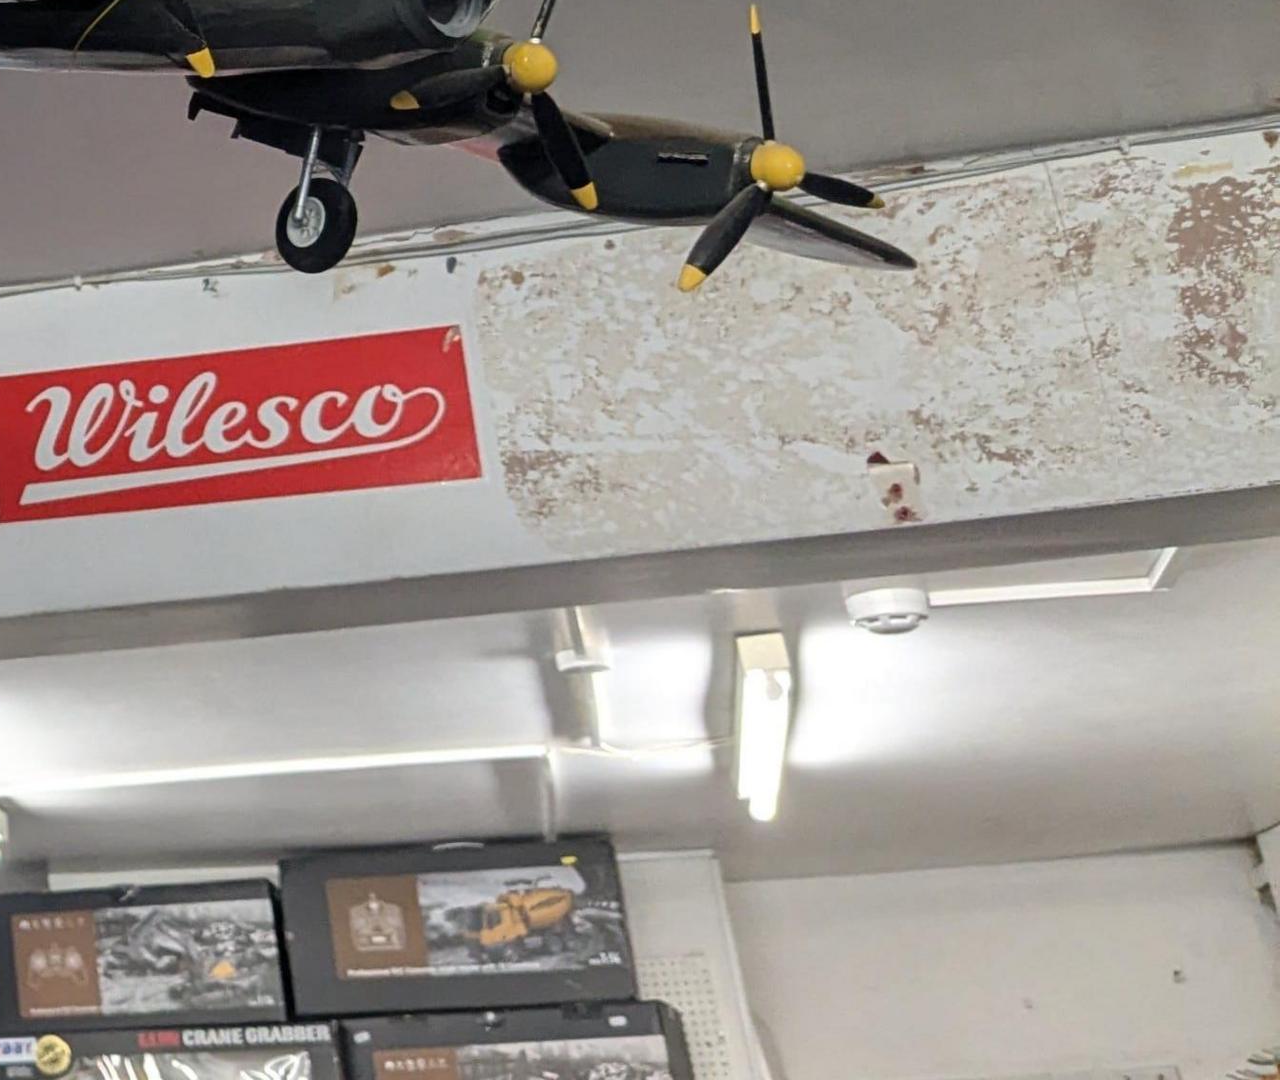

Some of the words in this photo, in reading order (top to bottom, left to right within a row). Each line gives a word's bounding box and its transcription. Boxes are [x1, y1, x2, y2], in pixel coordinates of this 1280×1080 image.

[25, 370, 446, 472] Wilesco
[181, 1026, 244, 1047] CRANE
[244, 1024, 332, 1044] GRABBER
